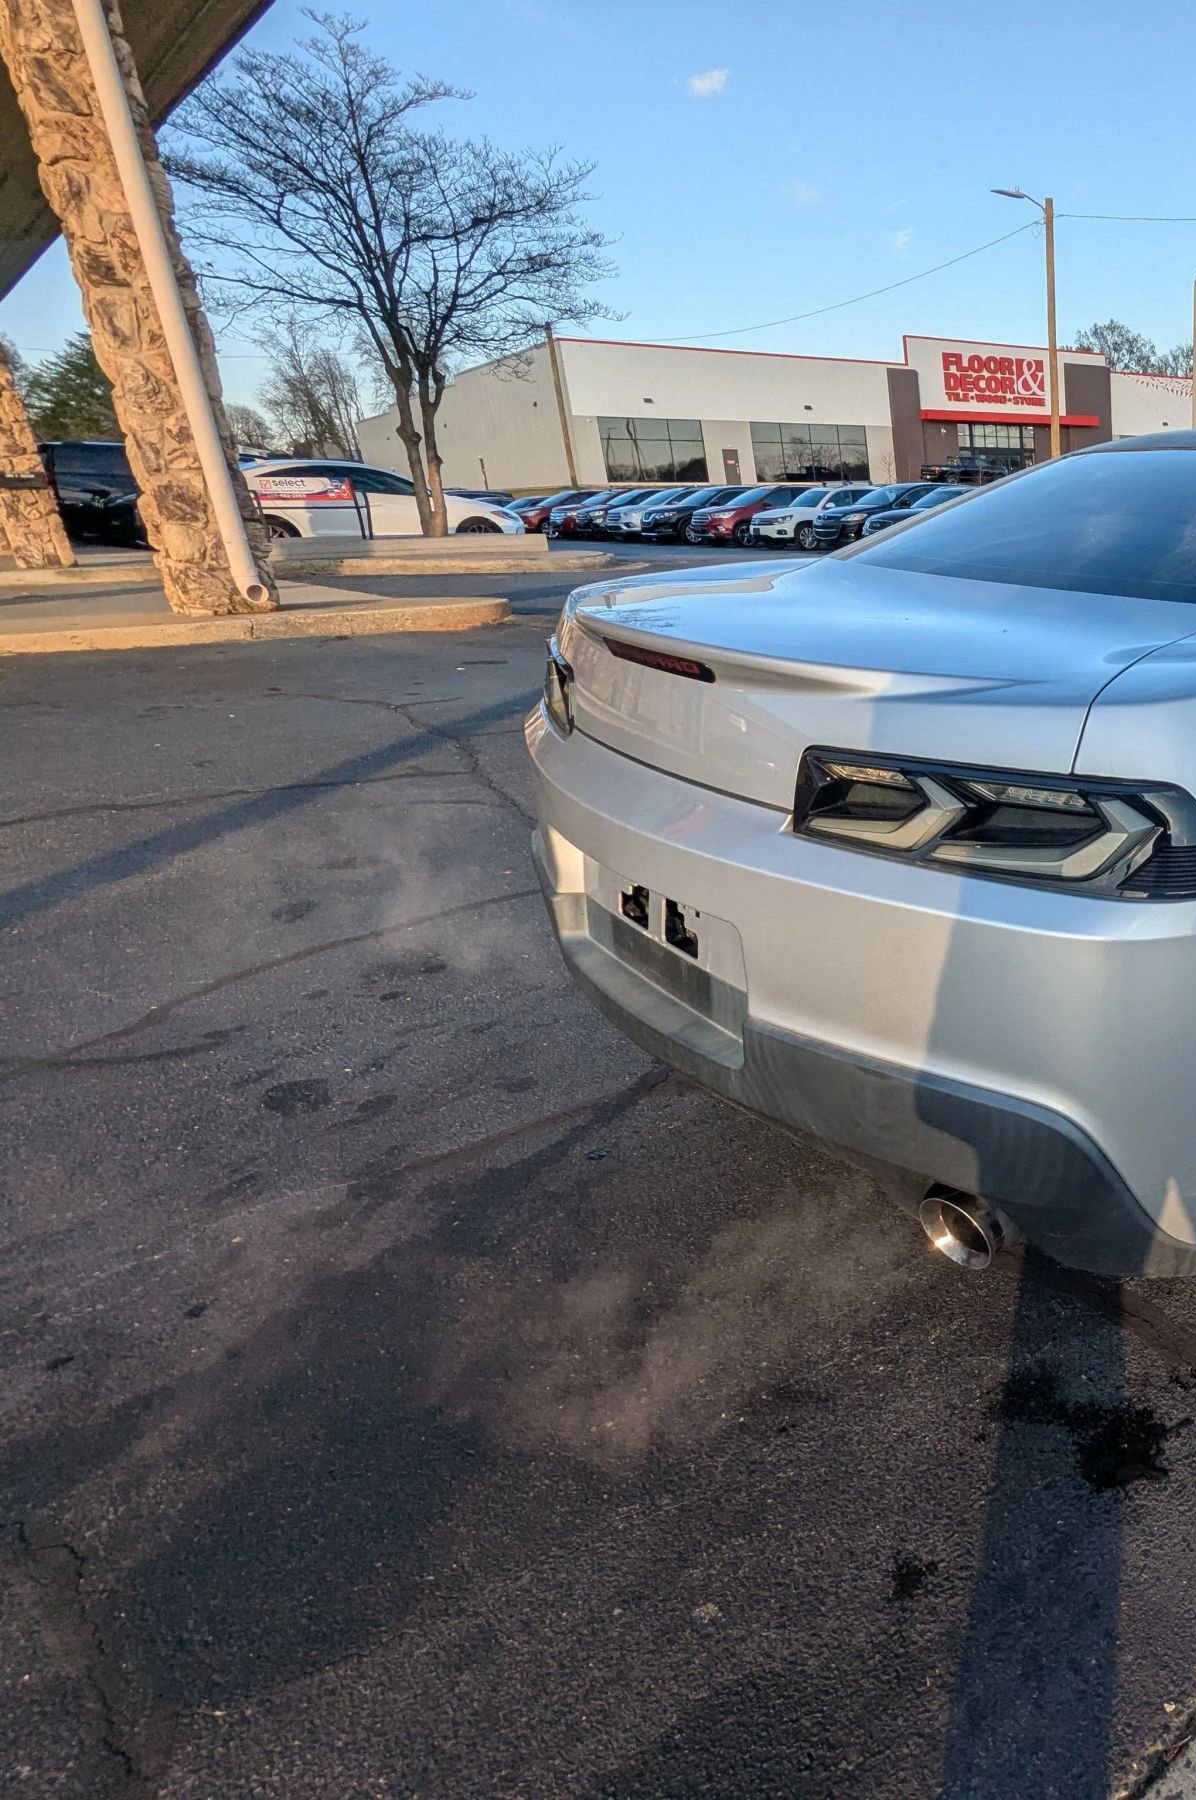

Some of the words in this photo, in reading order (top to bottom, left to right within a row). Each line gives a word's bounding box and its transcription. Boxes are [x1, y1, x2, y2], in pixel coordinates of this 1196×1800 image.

[942, 352, 1015, 376] FLOOR
[944, 372, 1016, 395] DECOR
[945, 392, 970, 402] TILE
[271, 479, 307, 487] select
